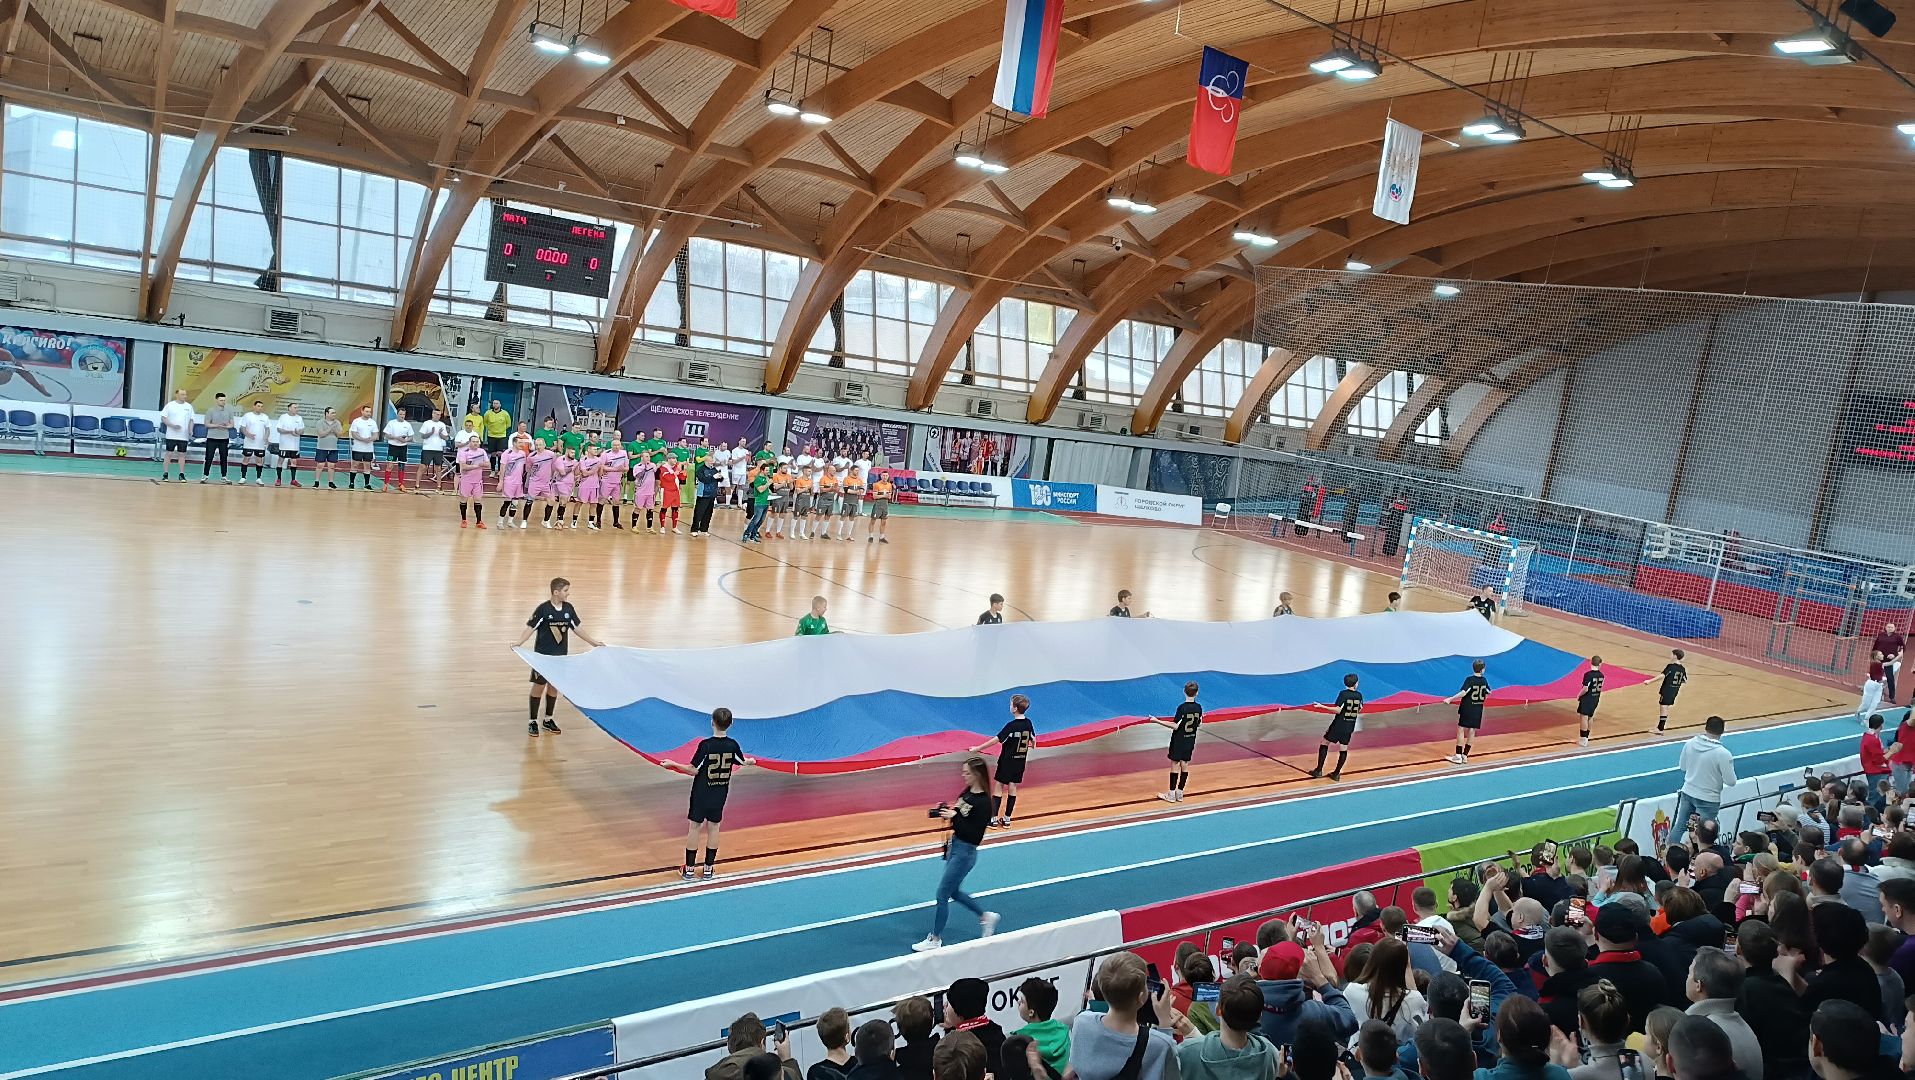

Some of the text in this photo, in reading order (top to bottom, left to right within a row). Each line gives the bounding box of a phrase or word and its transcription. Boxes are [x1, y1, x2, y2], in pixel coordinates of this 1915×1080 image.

[503, 213, 527, 225] МАТЧ
[571, 226, 606, 239] ЛЕГЕНД
[504, 243, 513, 256] 0
[589, 257, 599, 270] 0
[301, 366, 348, 377] ЛАУРЕАТ
[695, 409, 740, 421] ТЕЛЕВИДЕНИЕ
[1052, 491, 1080, 499] МИНСПОРТ
[1057, 497, 1077, 505] РОССИИ
[707, 752, 733, 780] 25
